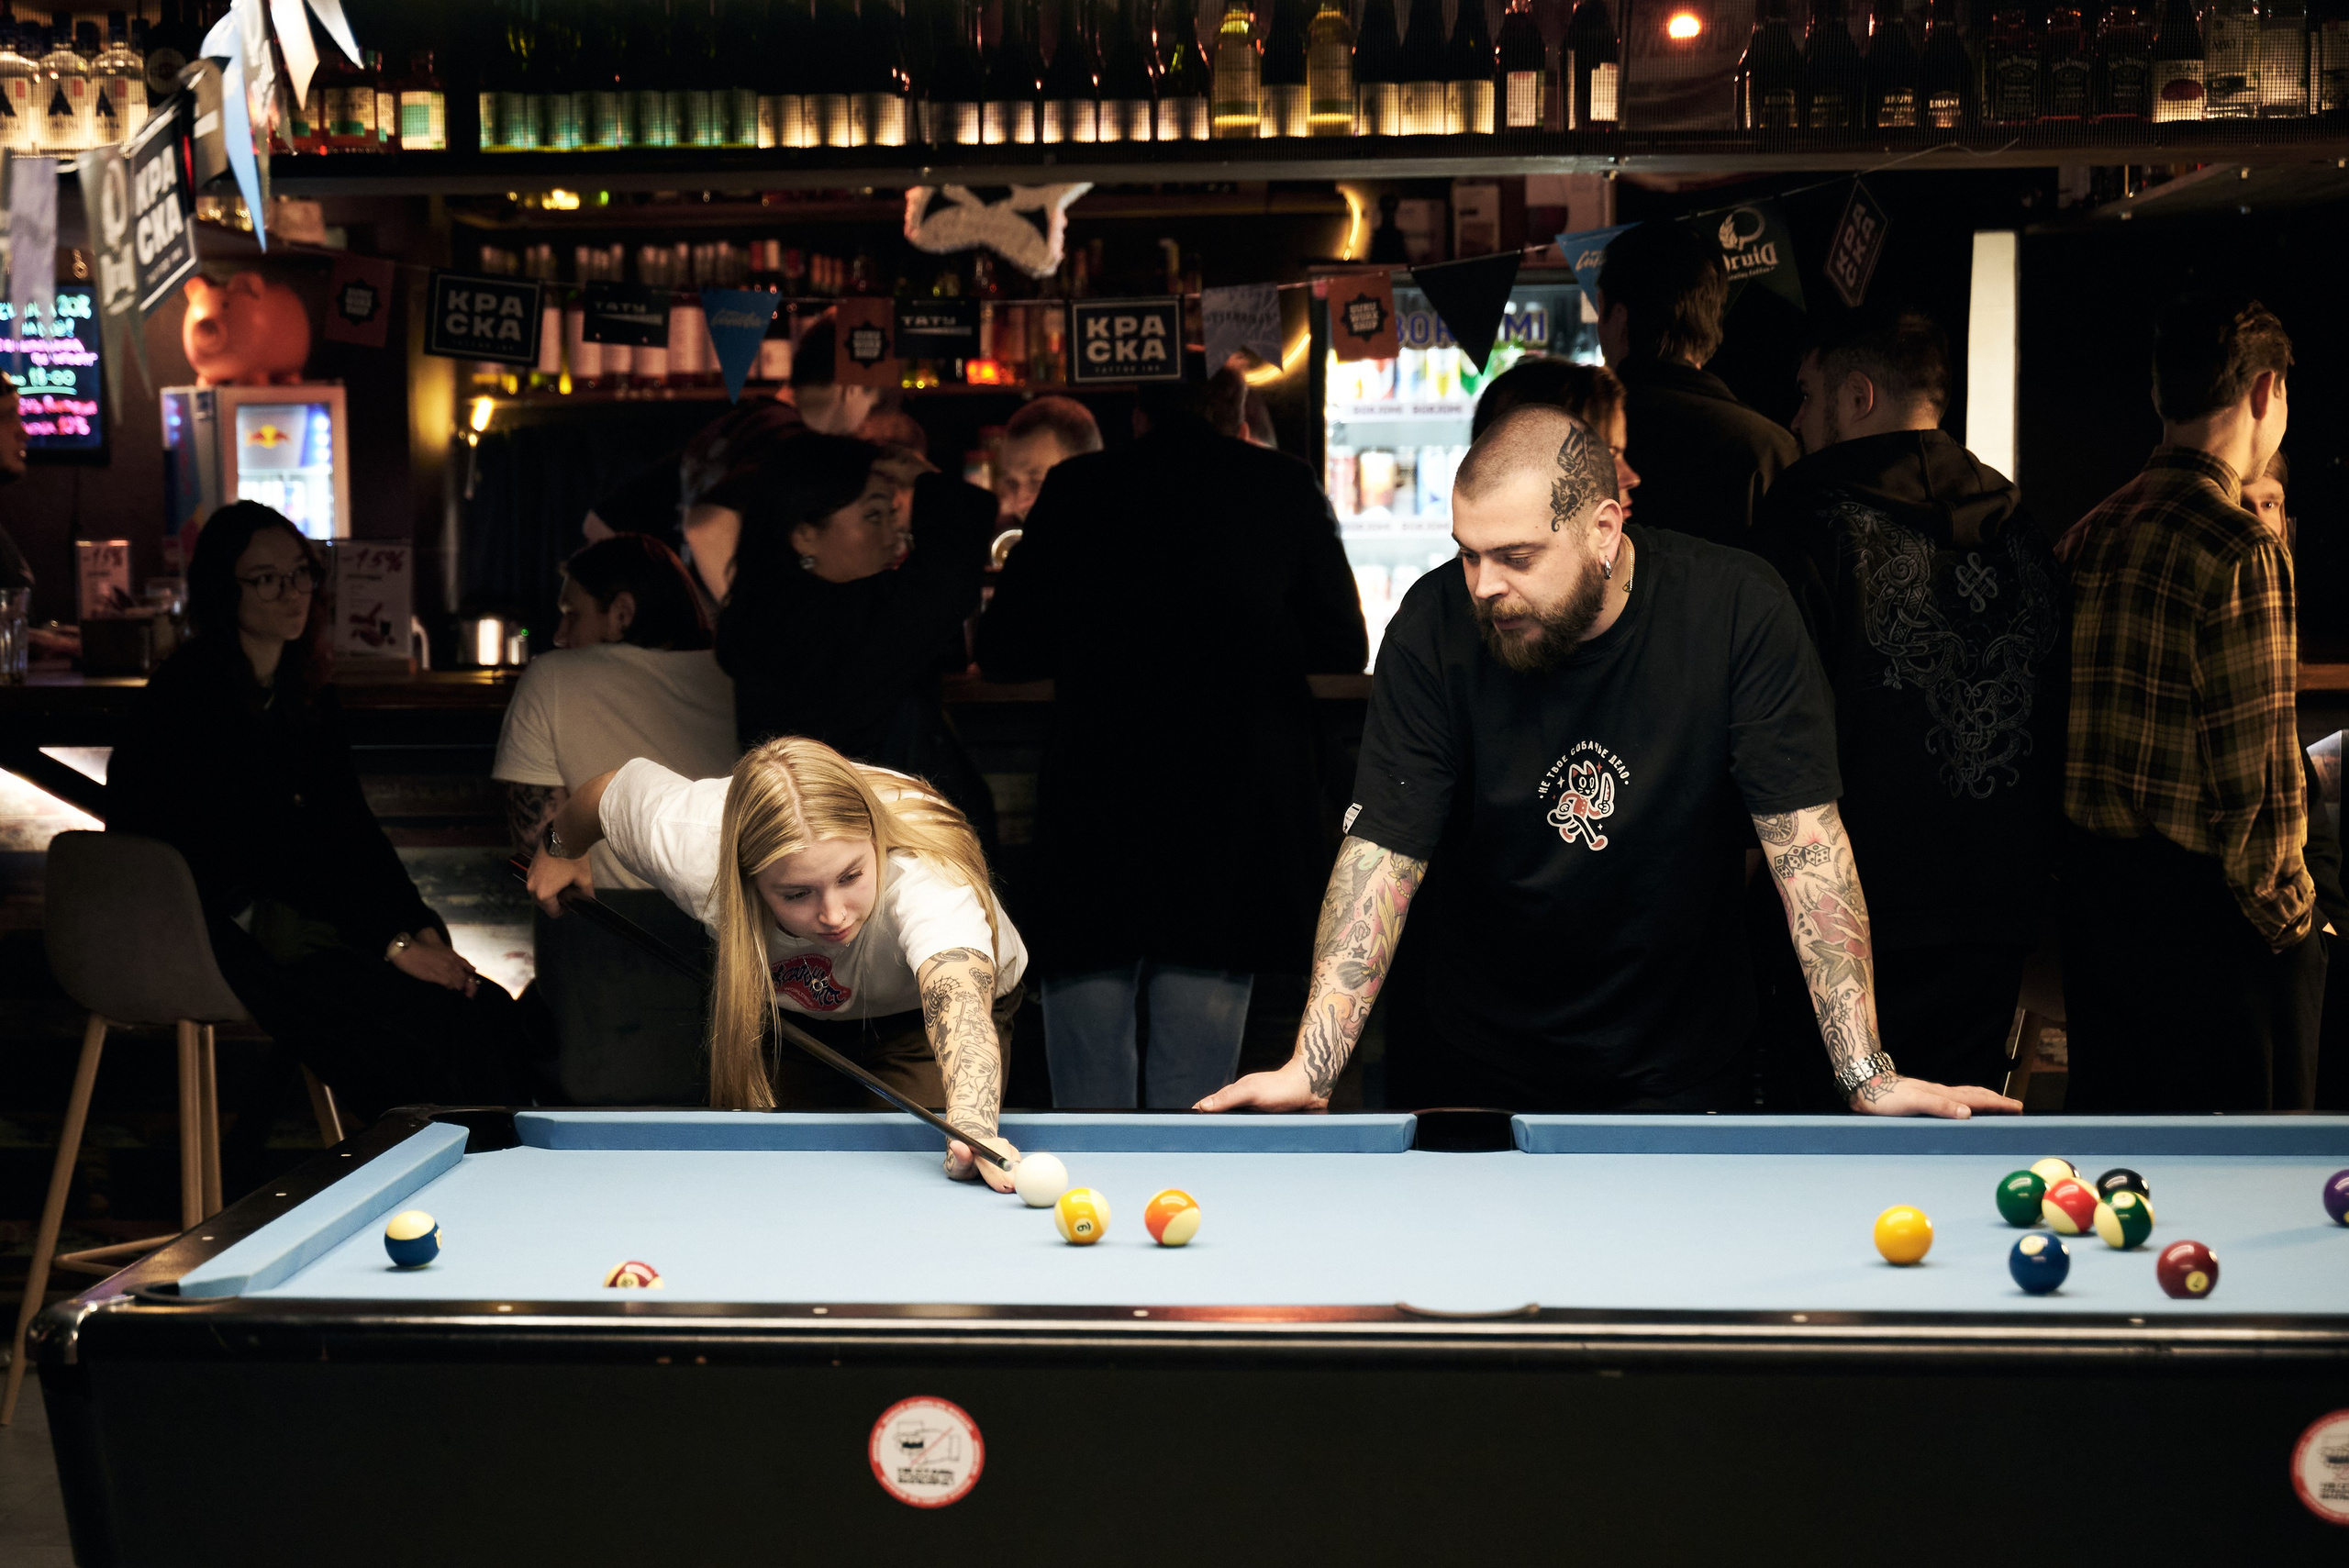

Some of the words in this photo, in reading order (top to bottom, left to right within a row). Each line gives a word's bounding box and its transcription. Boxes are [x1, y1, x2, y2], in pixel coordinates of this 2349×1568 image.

[138, 191, 184, 265] СКА
[446, 288, 525, 319] КРА
[444, 312, 522, 342] СКА
[1085, 314, 1166, 339] КРА
[1085, 338, 1167, 364] СКА
[1538, 780, 1551, 794] НЕ
[1546, 755, 1568, 778] ТВОЕ
[1570, 740, 1609, 759] СОБАЧЬЕ
[1608, 754, 1631, 779] ДЕЛО
